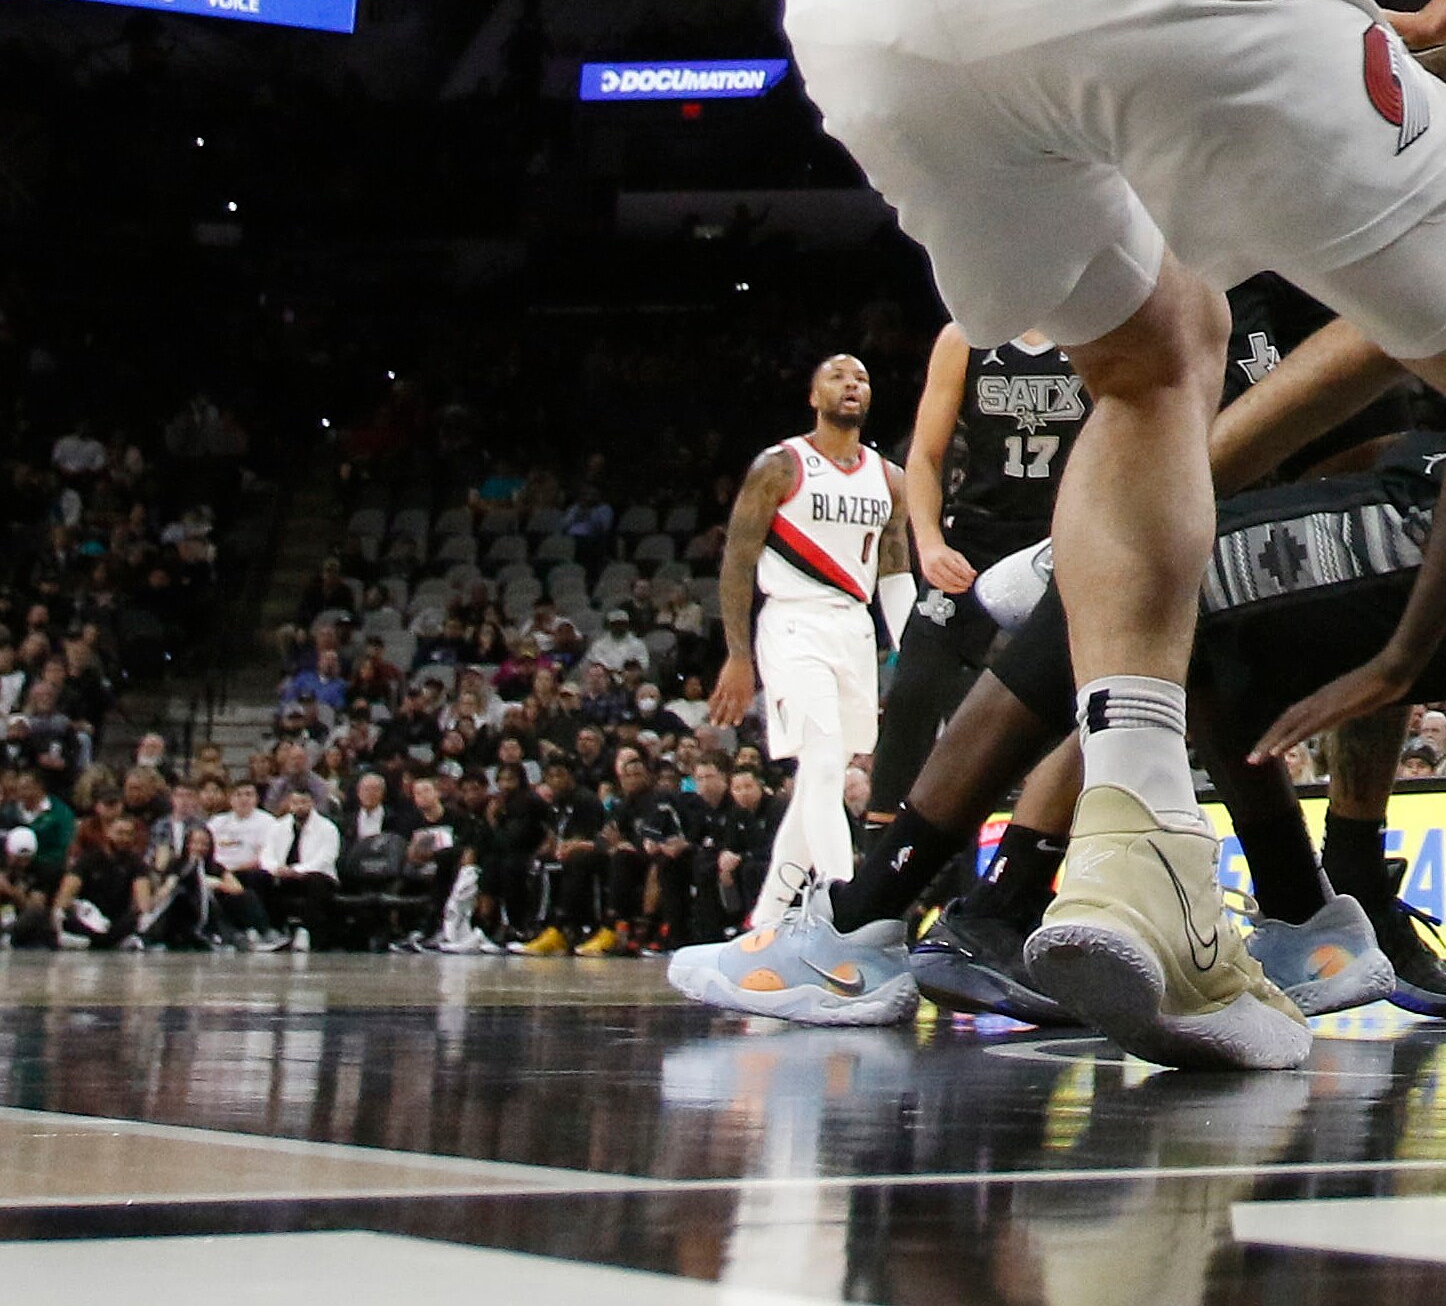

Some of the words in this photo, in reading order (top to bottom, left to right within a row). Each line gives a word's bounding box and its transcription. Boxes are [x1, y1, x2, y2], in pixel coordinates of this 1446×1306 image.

[620, 68, 767, 93] DOCUMATION
[977, 375, 1086, 422] SATX
[1004, 436, 1060, 479] 17
[811, 493, 890, 528] BLAZERS
[861, 531, 876, 565] 0
